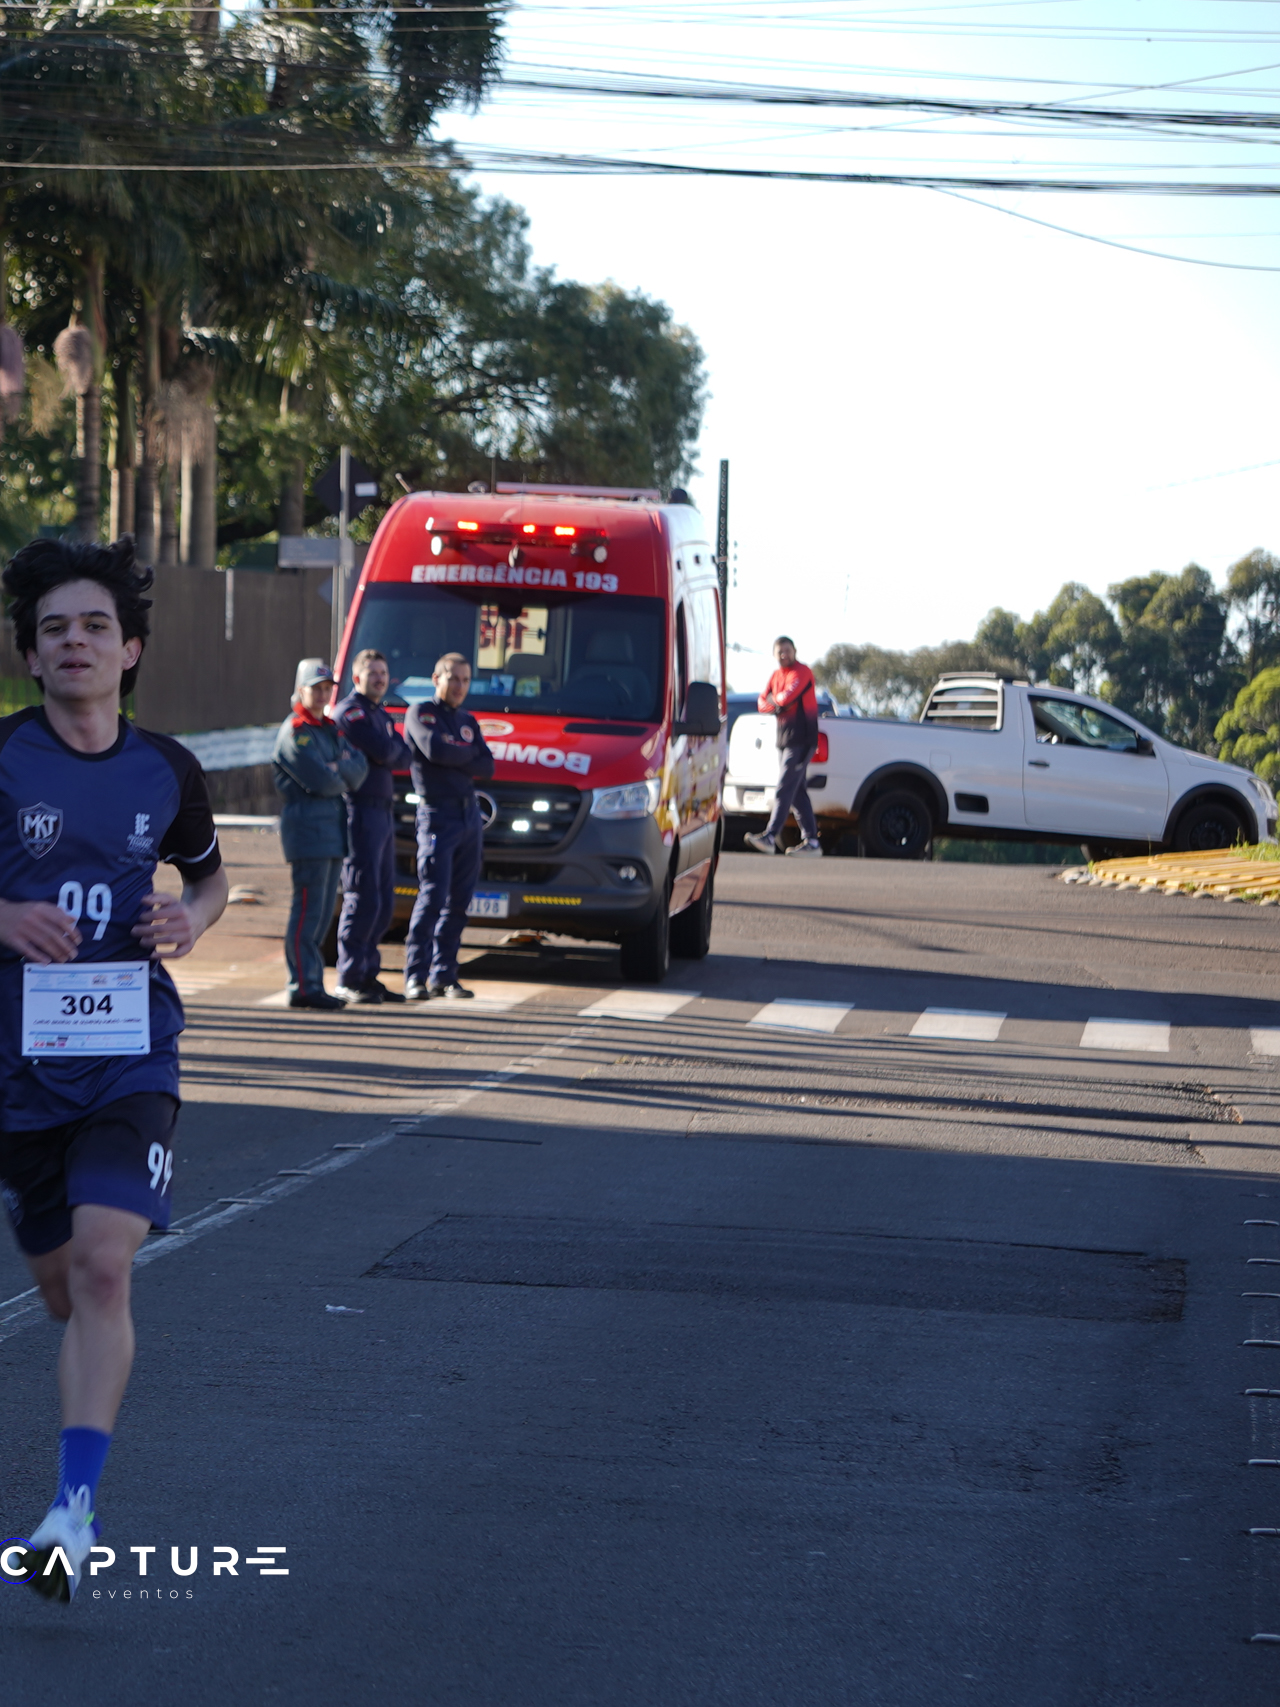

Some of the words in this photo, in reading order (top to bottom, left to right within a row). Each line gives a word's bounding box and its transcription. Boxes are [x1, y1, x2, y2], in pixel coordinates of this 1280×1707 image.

[410, 562, 567, 587] EMERGÊNCIA
[573, 571, 618, 592] 193
[23, 813, 58, 839] MKT
[57, 880, 112, 941] 99
[60, 993, 114, 1015] 304
